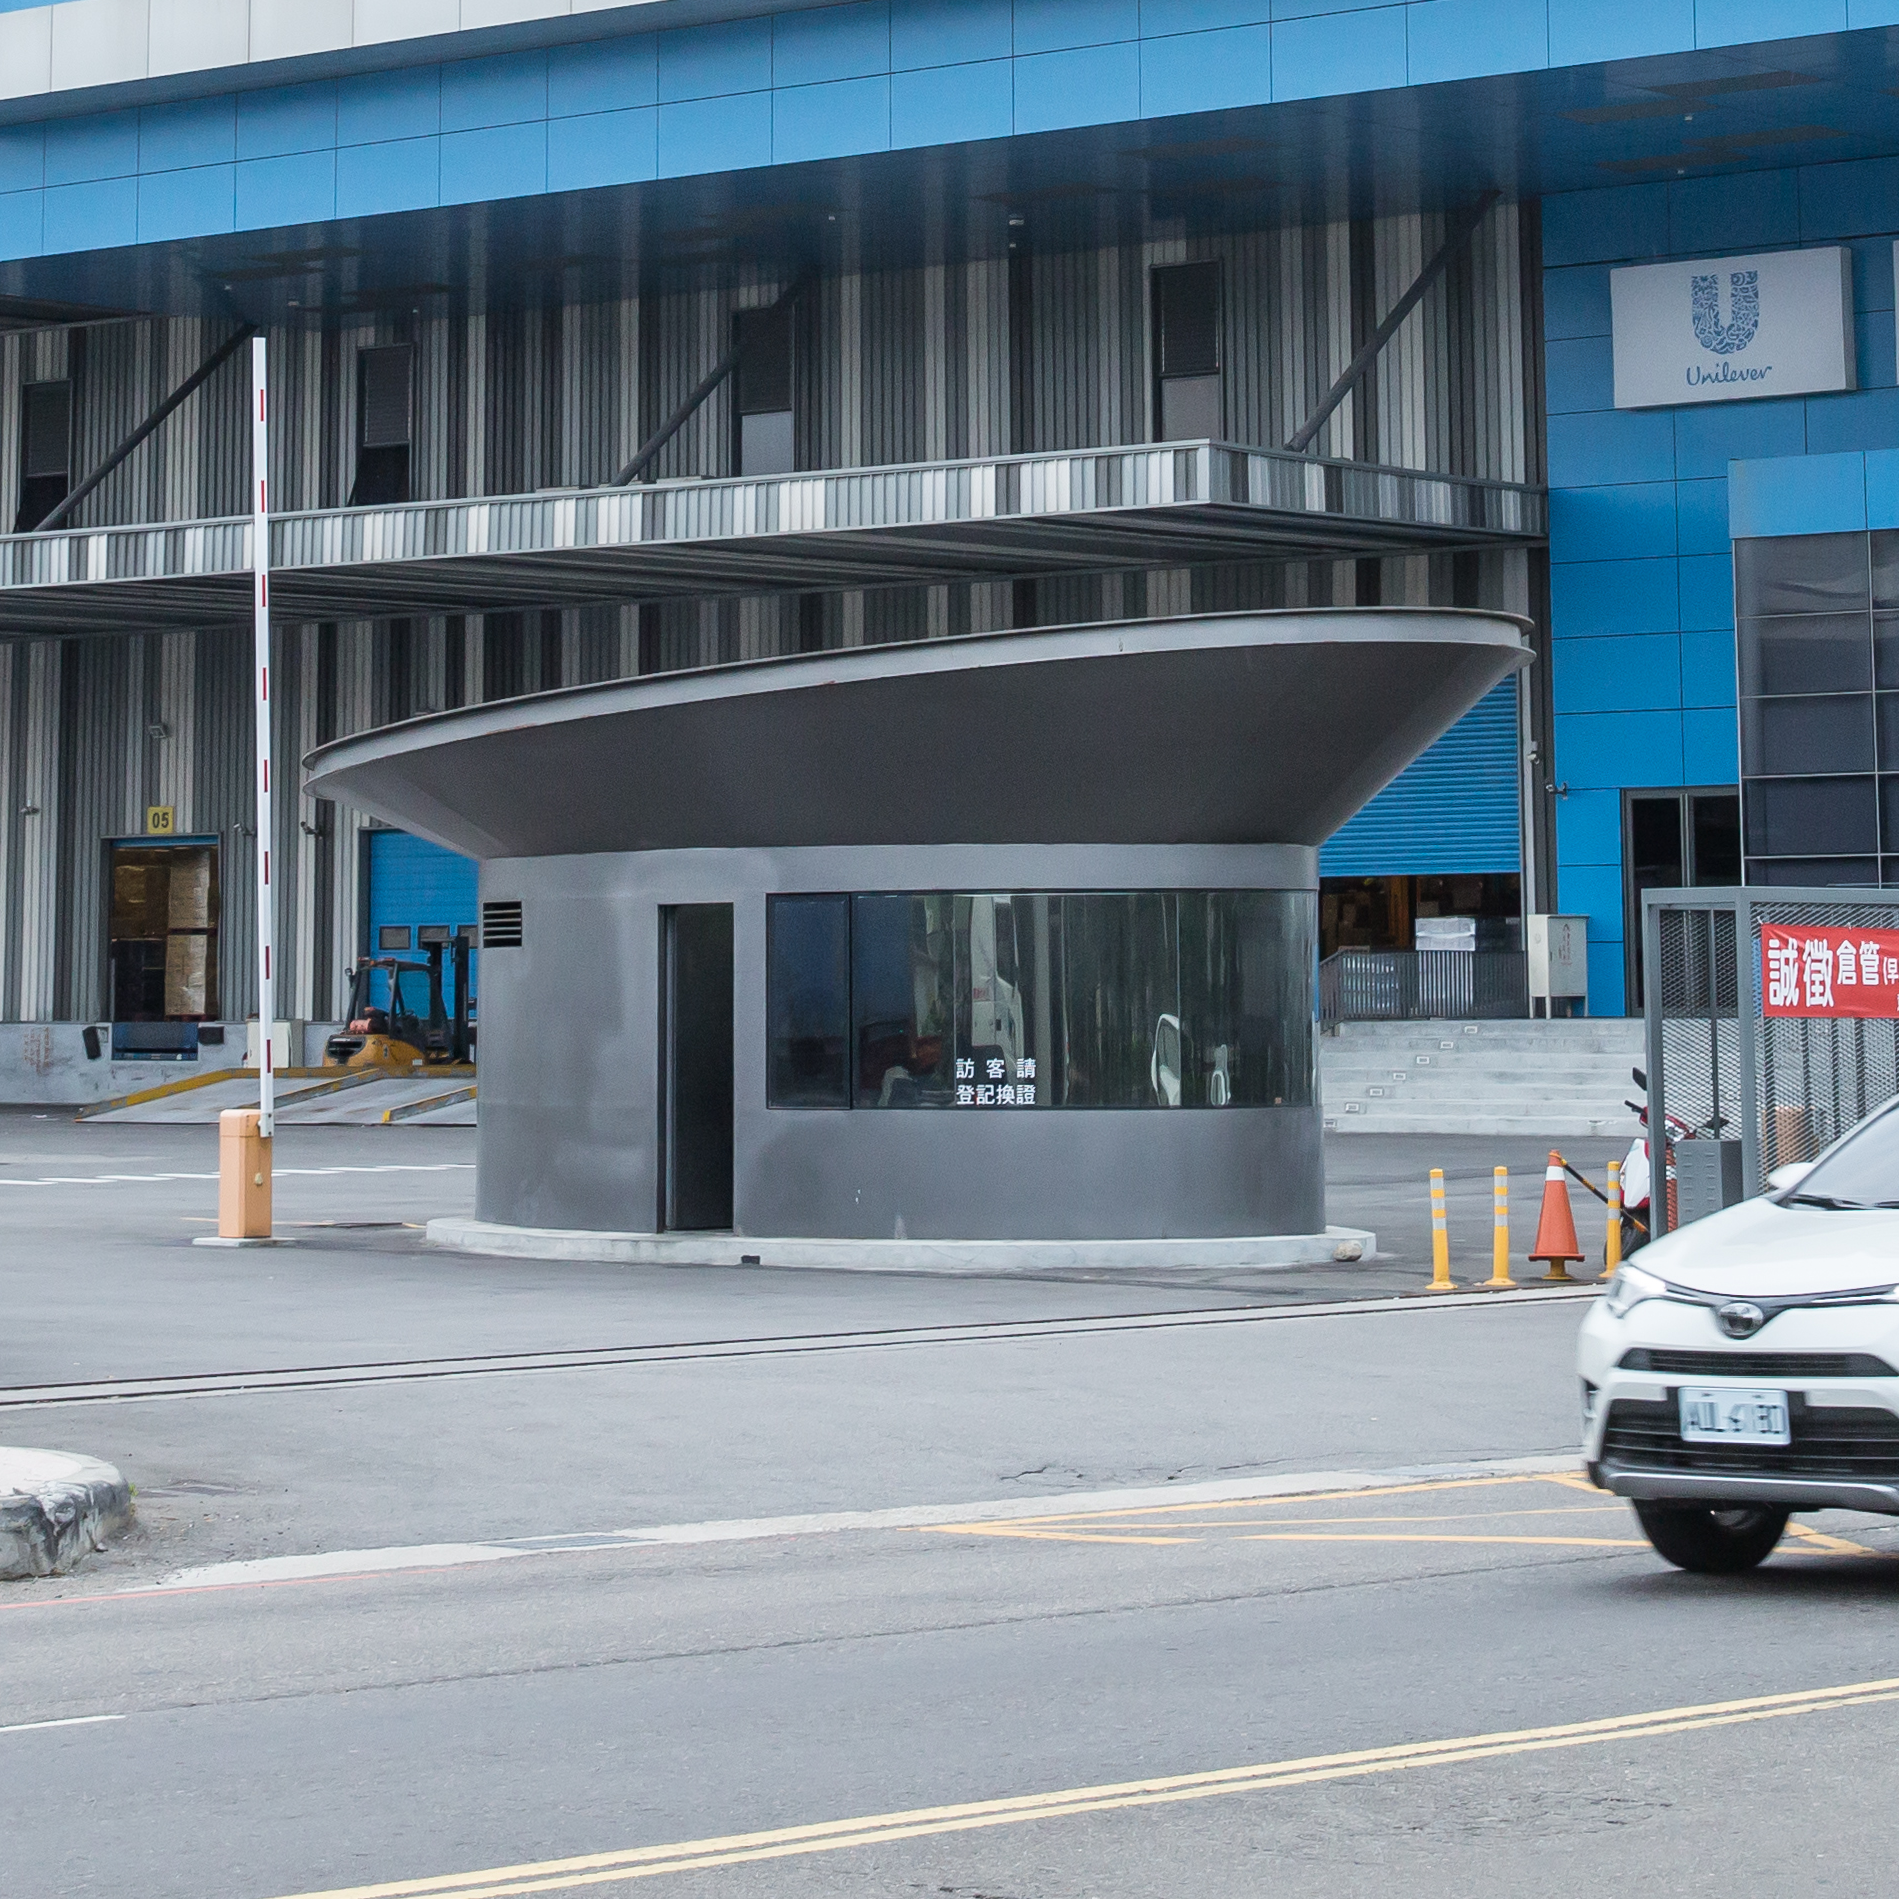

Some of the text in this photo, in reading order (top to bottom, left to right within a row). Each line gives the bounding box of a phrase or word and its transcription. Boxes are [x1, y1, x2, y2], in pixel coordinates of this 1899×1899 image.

[1686, 361, 1773, 386] Unilever
[152, 811, 170, 829] 05
[956, 1083, 1036, 1105] 登記換證
